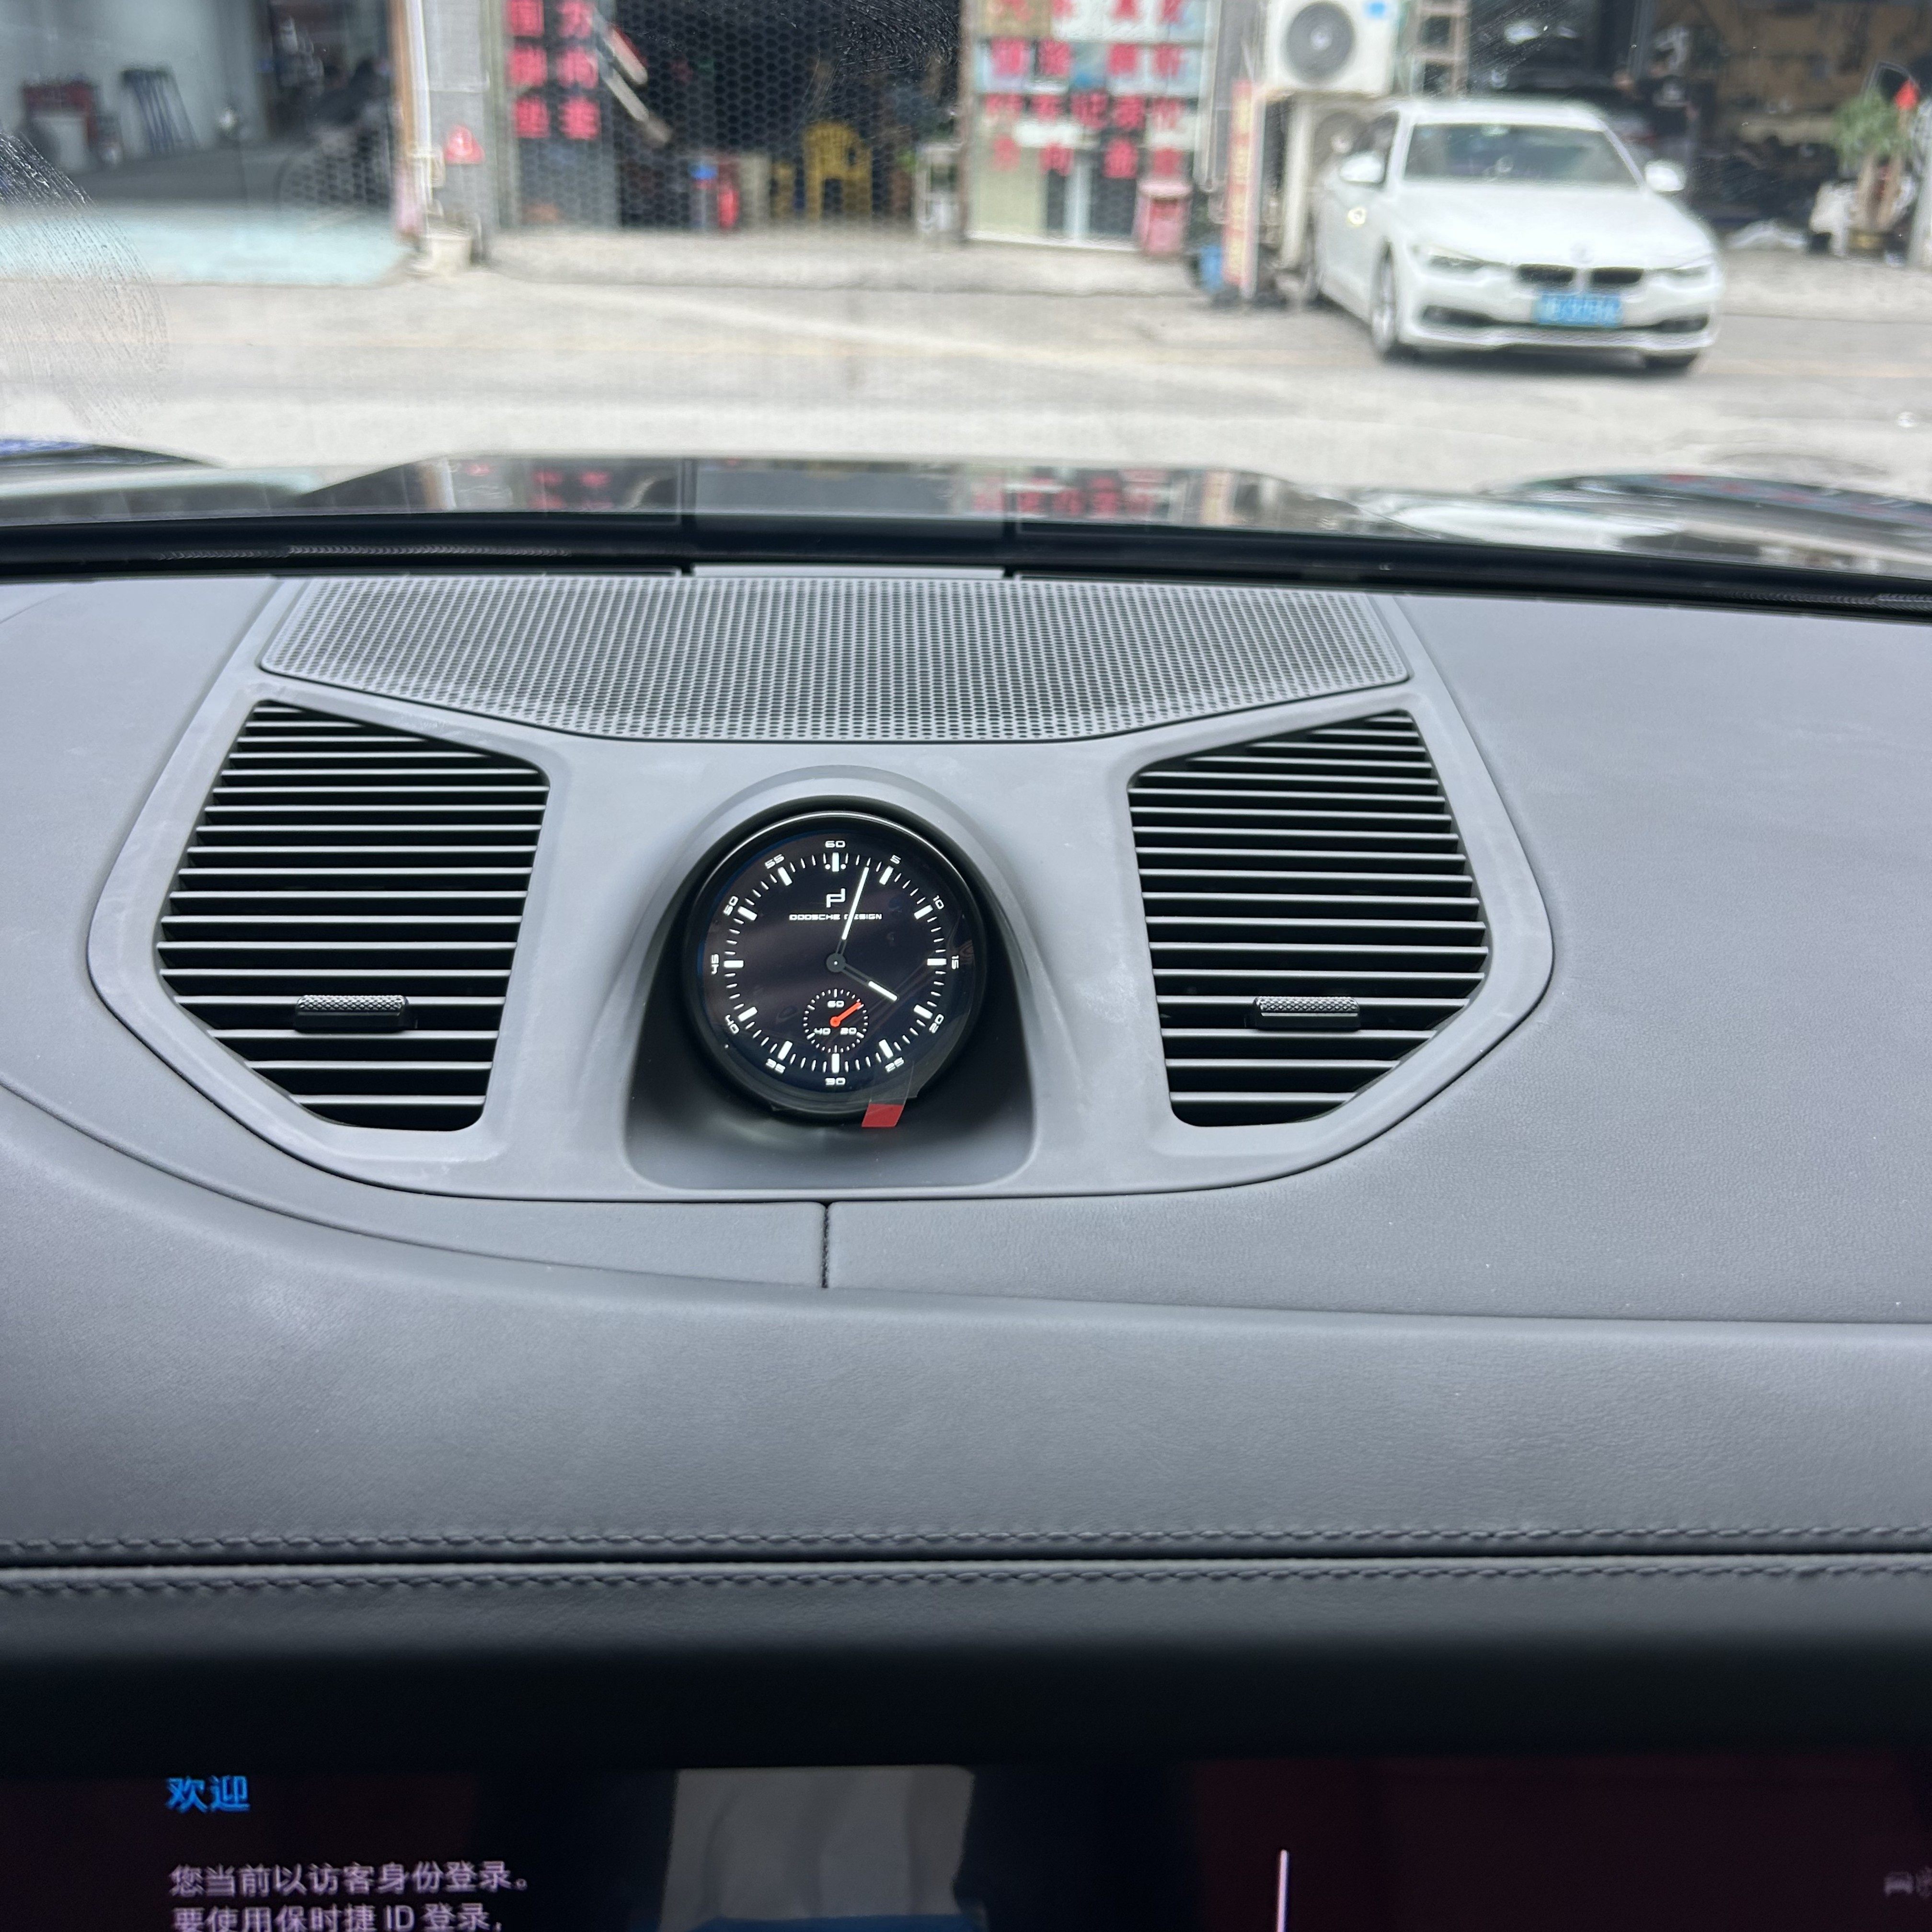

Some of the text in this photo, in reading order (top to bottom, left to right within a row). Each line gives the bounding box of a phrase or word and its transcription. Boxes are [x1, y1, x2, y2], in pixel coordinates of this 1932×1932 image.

[765, 854, 785, 868] 55
[889, 855, 901, 864] 5
[723, 896, 739, 916] 50
[933, 896, 944, 909] 10
[711, 954, 719, 975] 45
[951, 955, 959, 970] 15
[725, 1015, 740, 1034] 40
[929, 1014, 944, 1033] 20
[885, 1057, 904, 1072] 25
[167, 1775, 250, 1813] 欢迎
[169, 1861, 527, 1897] 您当前以访客身份登录。
[172, 1904, 377, 1932] 要使用保时捷
[385, 1905, 415, 1932] ID
